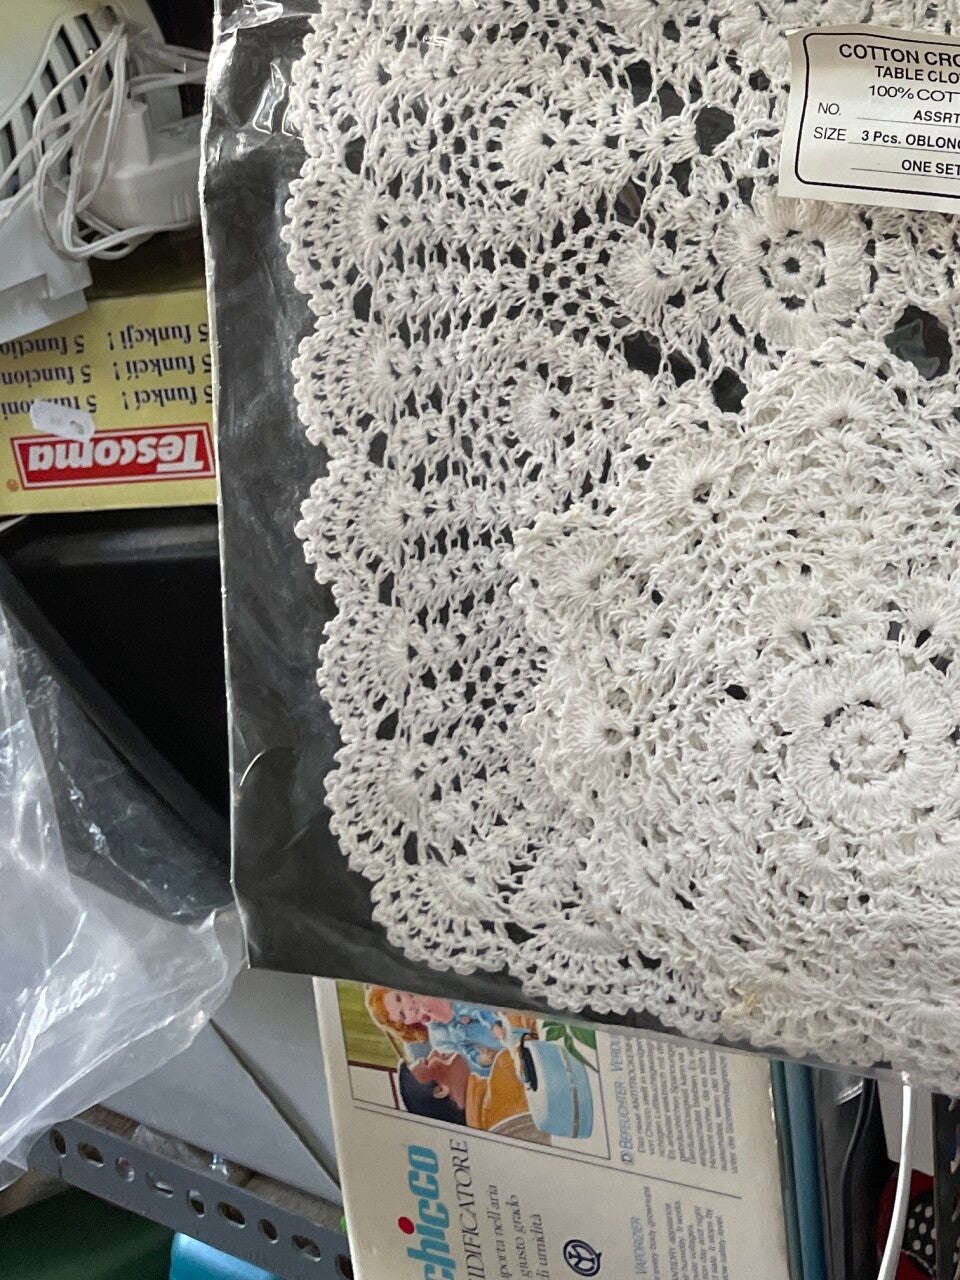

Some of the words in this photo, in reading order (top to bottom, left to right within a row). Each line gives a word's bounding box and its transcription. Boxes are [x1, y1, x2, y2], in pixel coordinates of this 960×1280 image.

[838, 43, 920, 65] COTTON
[874, 65, 924, 81] TABLE
[868, 84, 914, 100] 100%
[817, 102, 842, 116] NO.
[813, 126, 847, 141] SIZE
[861, 130, 870, 142] 3
[872, 131, 902, 145] Pcs.
[901, 159, 932, 173] ONE
[75, 334, 85, 354] 5
[120, 324, 191, 349] funkcji
[80, 364, 91, 384] 5
[85, 394, 97, 414] 5
[27, 433, 205, 473] Tescoma
